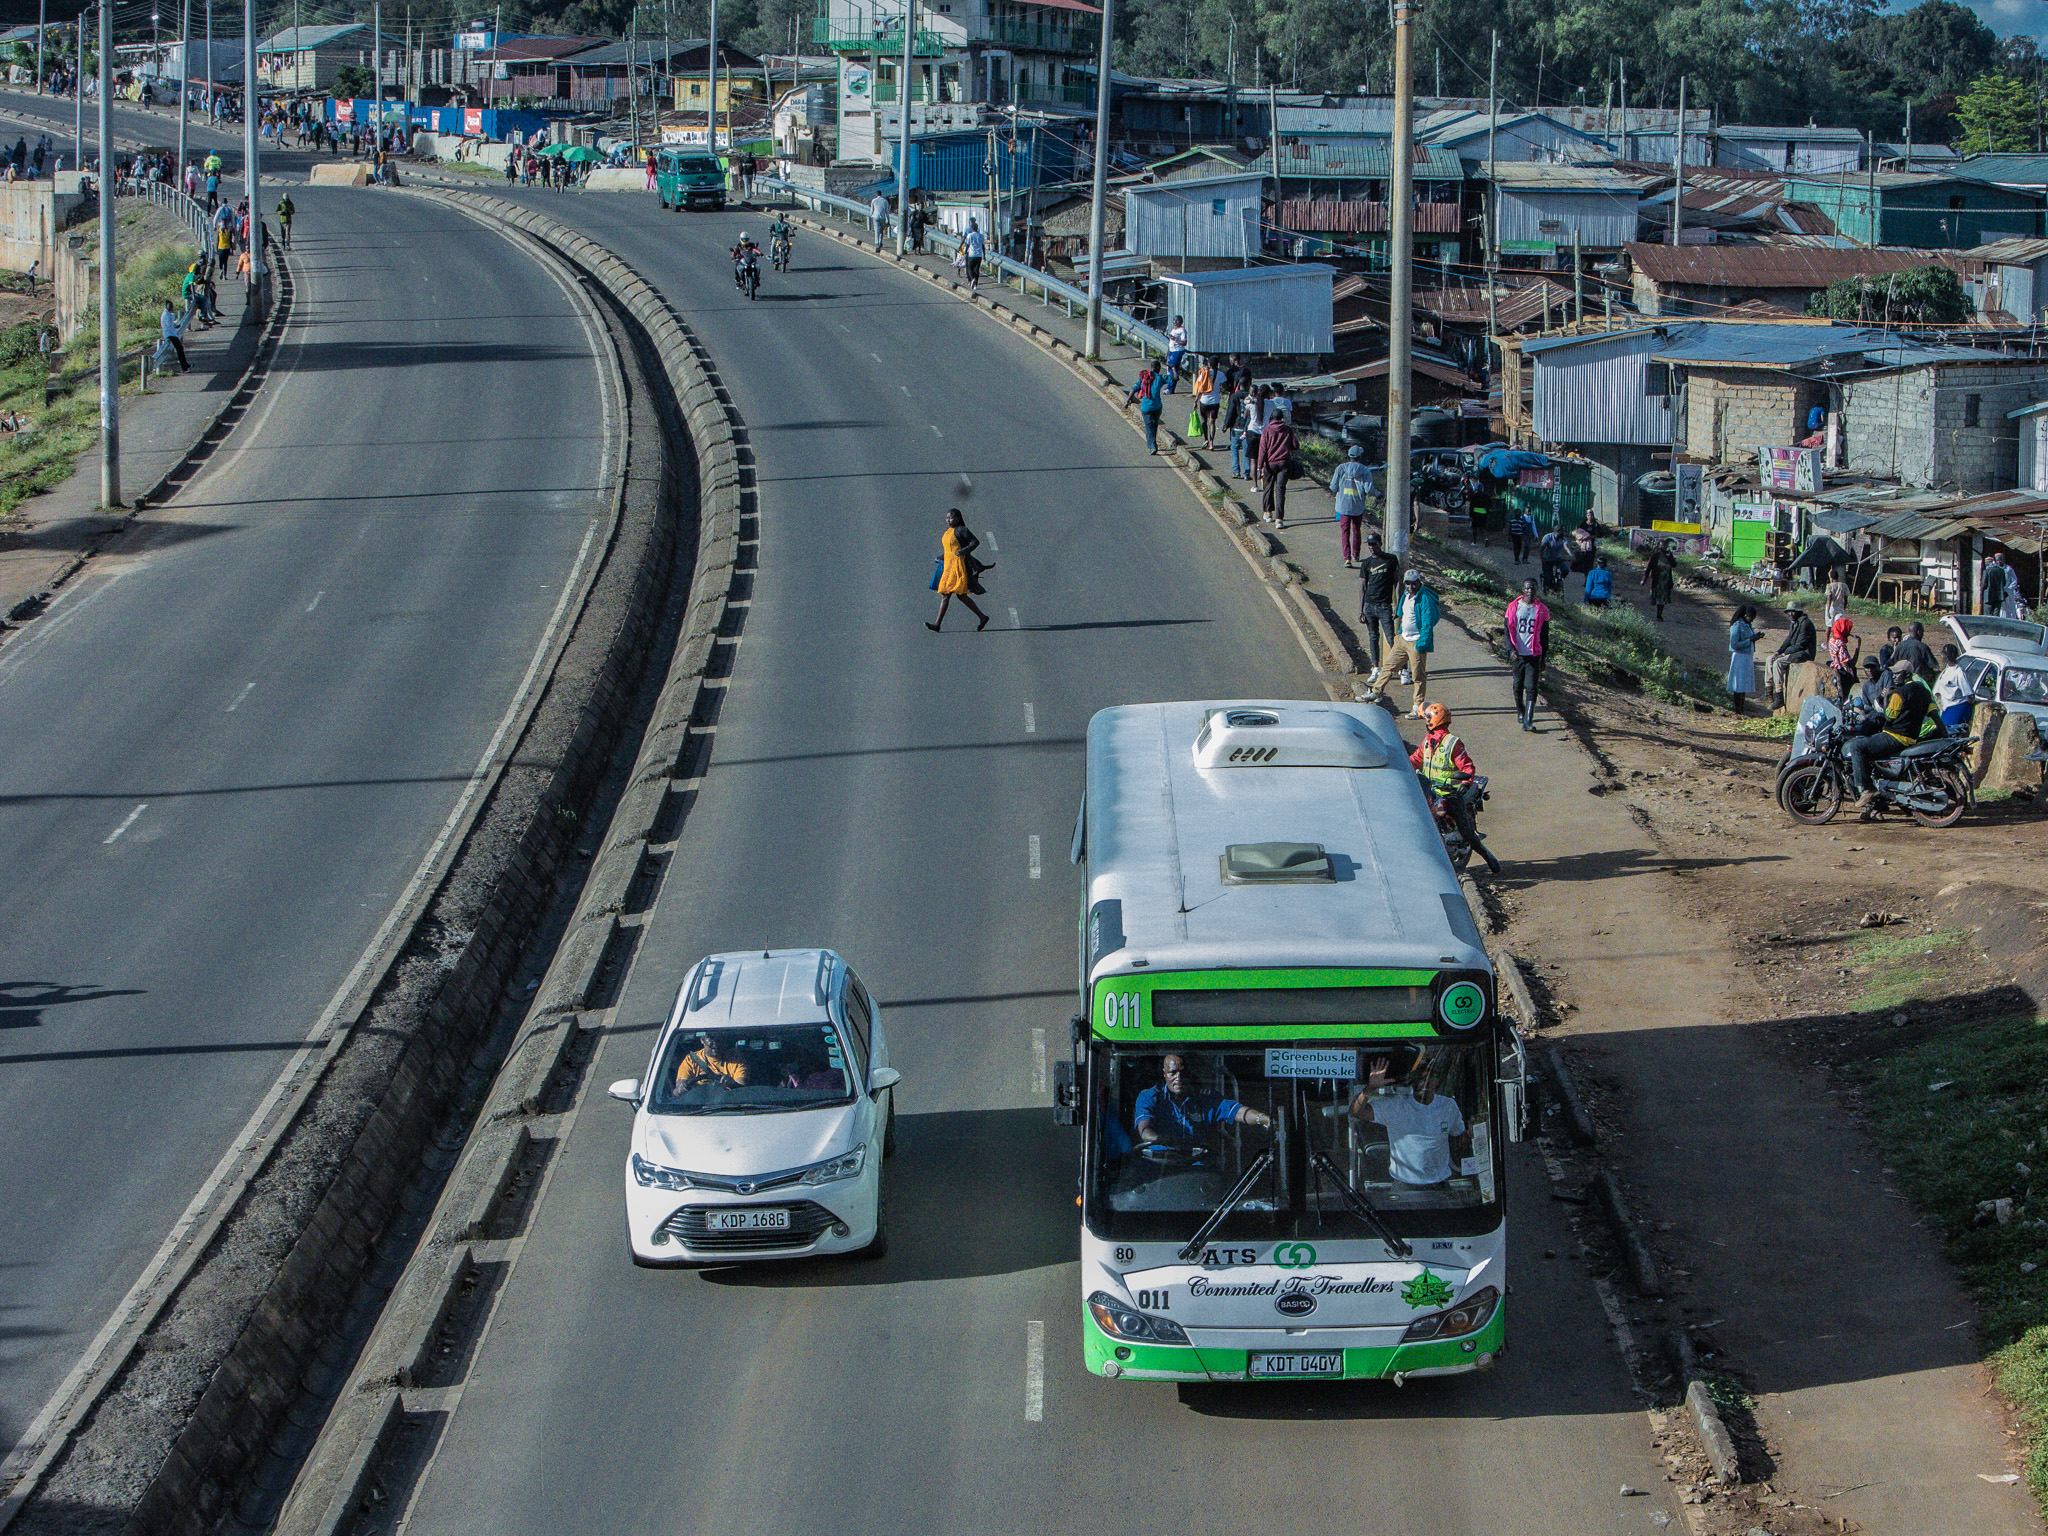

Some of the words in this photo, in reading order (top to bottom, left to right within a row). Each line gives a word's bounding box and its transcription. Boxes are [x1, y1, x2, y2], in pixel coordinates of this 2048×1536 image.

[1104, 991, 1141, 1029] 011
[1281, 1051, 1355, 1063] Greenbus.ke
[1281, 1064, 1355, 1076] Greenbus.ke
[720, 1214, 746, 1228] KDP
[752, 1212, 785, 1227] 168G
[1116, 1247, 1134, 1260] 80
[1203, 1248, 1257, 1264] ATS
[1188, 1275, 1280, 1298] Commited
[1281, 1276, 1312, 1294] To
[1310, 1275, 1394, 1296] Travellers
[1138, 1289, 1170, 1310] 011
[1266, 1356, 1295, 1371] KDT
[1300, 1356, 1337, 1371] 040Y
